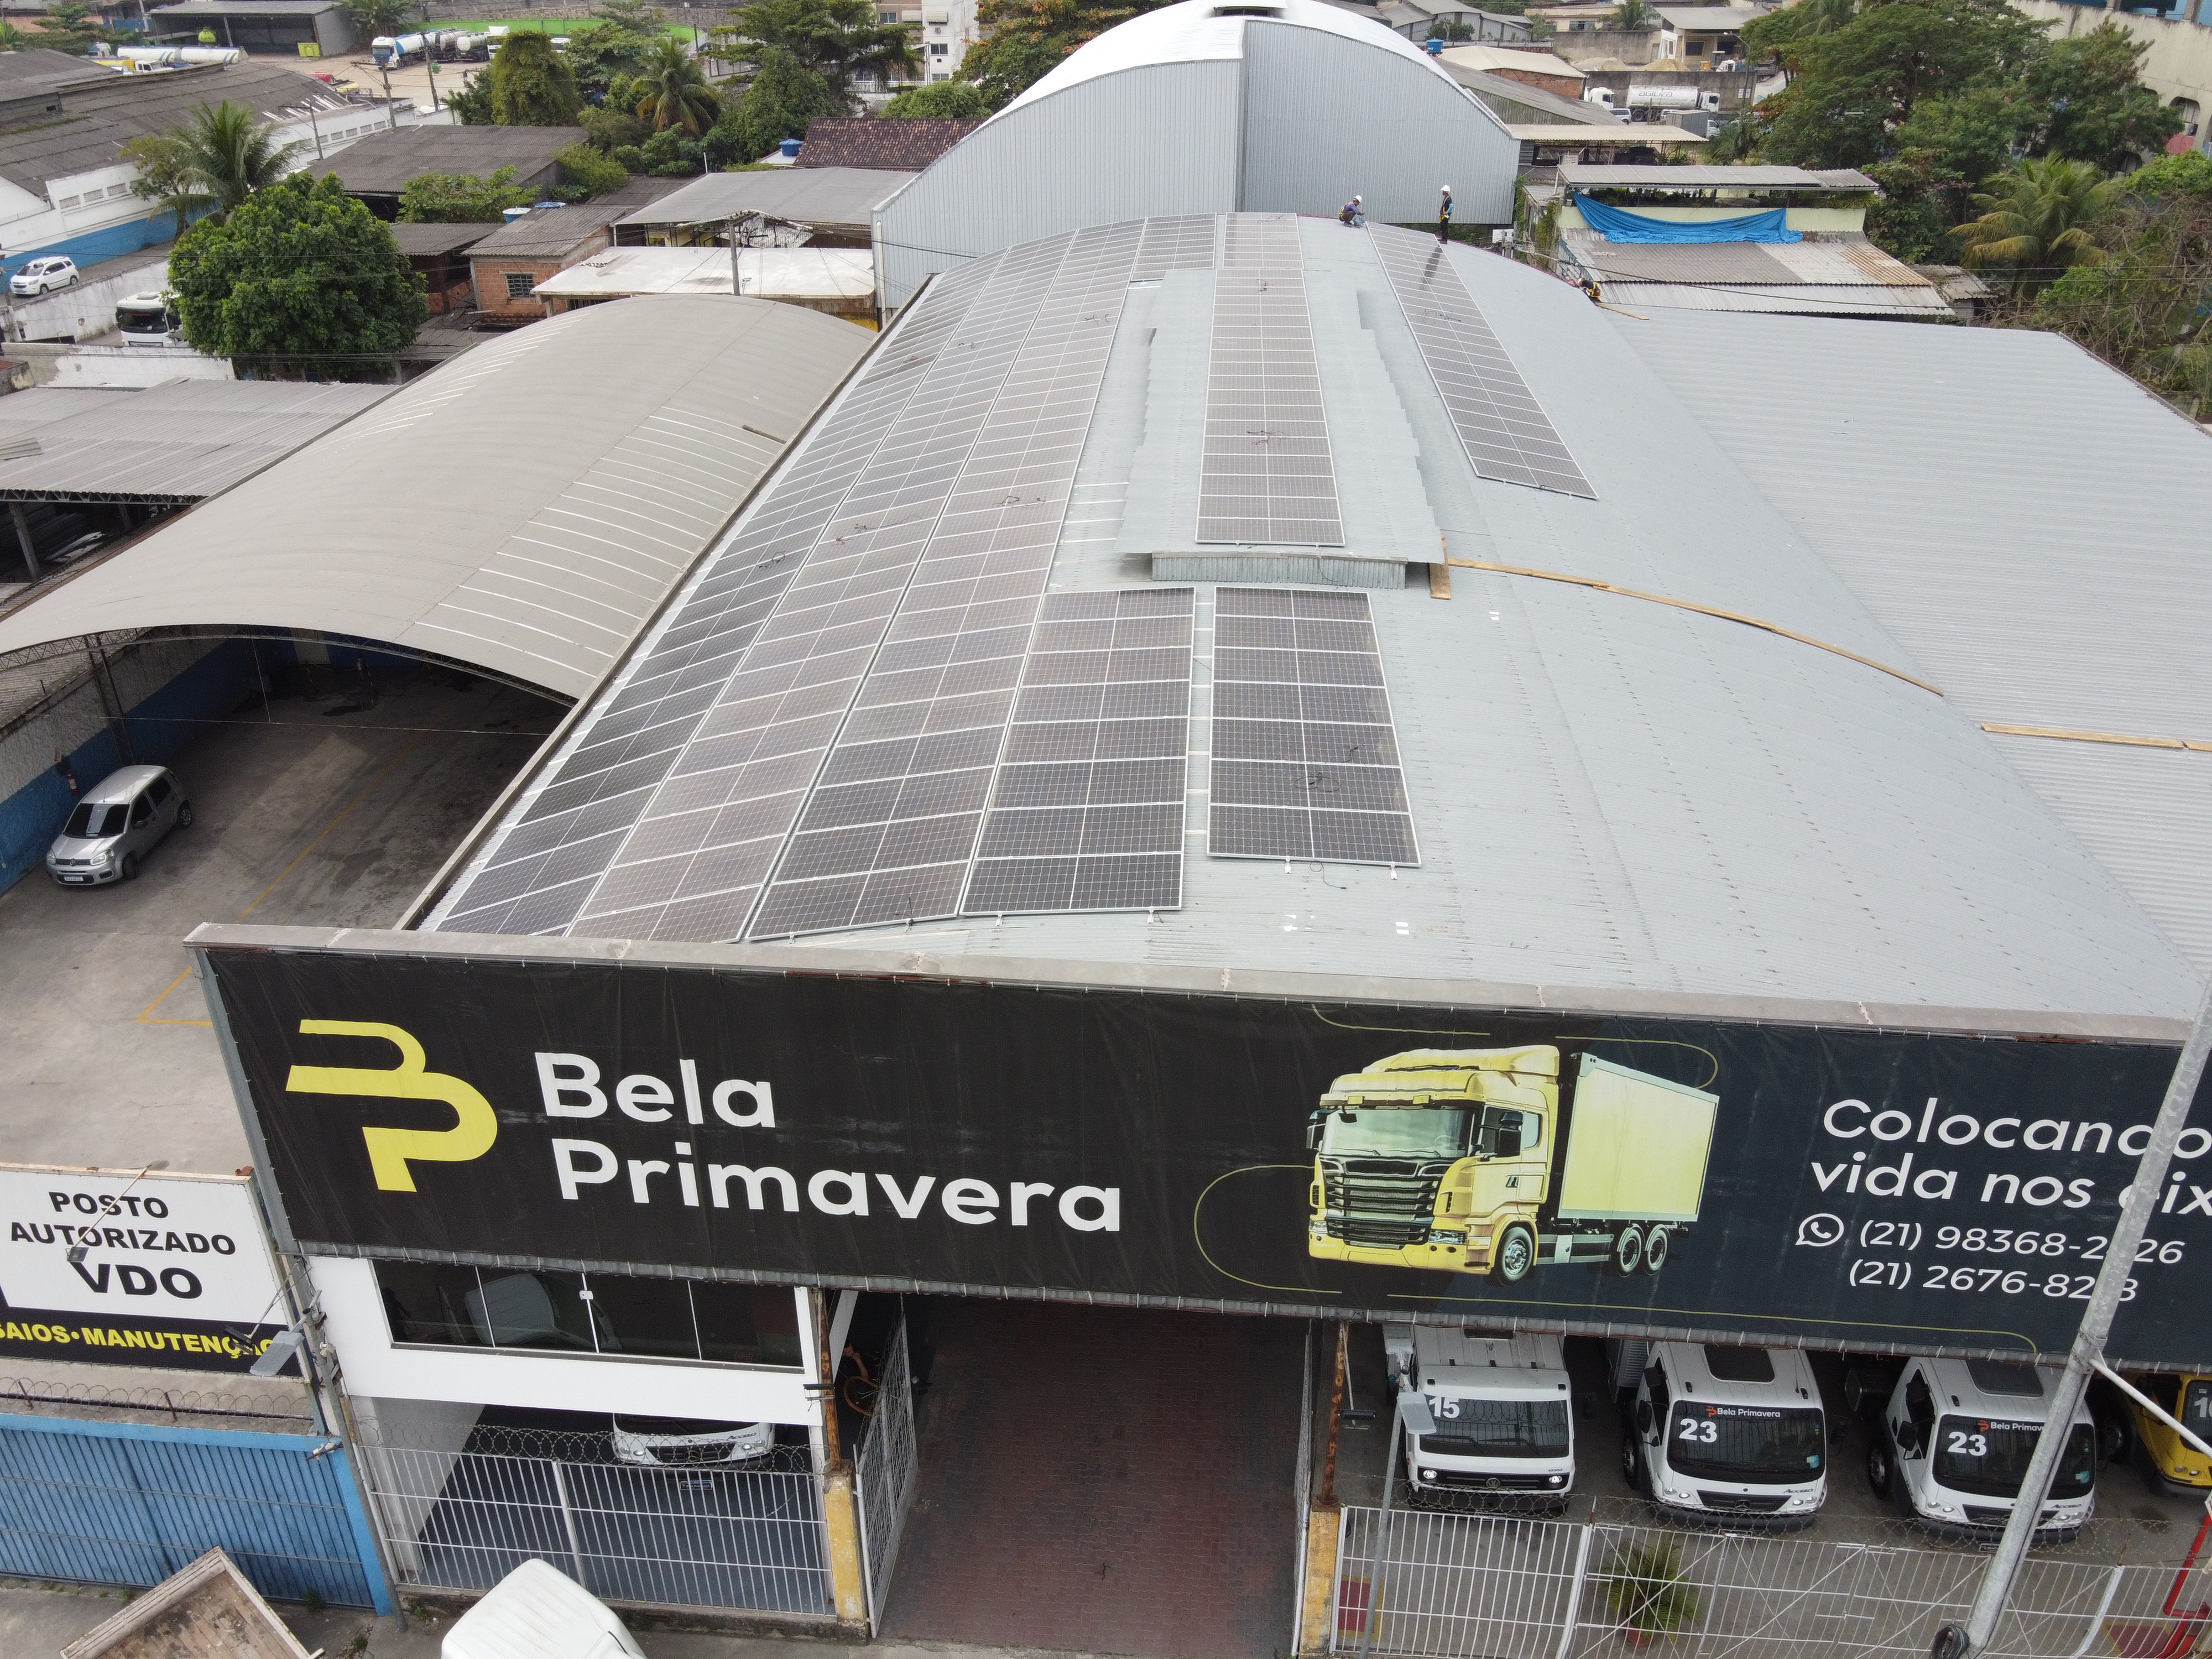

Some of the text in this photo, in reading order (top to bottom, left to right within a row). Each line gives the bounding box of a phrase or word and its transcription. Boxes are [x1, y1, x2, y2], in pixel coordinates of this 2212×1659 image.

[535, 1052, 775, 1128] Bela
[552, 1139, 1119, 1231] Primavera
[1812, 1152, 1958, 1199] vida
[1981, 1174, 2095, 1208] nos
[49, 1192, 168, 1218] POSTO
[12, 1222, 235, 1255] AUTORIZADO
[1861, 1220, 2185, 1264] (21) 98368-226
[67, 1261, 202, 1298] VDO
[1850, 1259, 1911, 1289] (21)
[1429, 1396, 1460, 1418] 15
[1717, 1407, 1781, 1417] Bela Primavera
[1679, 1418, 1717, 1443] 23
[1947, 1431, 1987, 1457] 23
